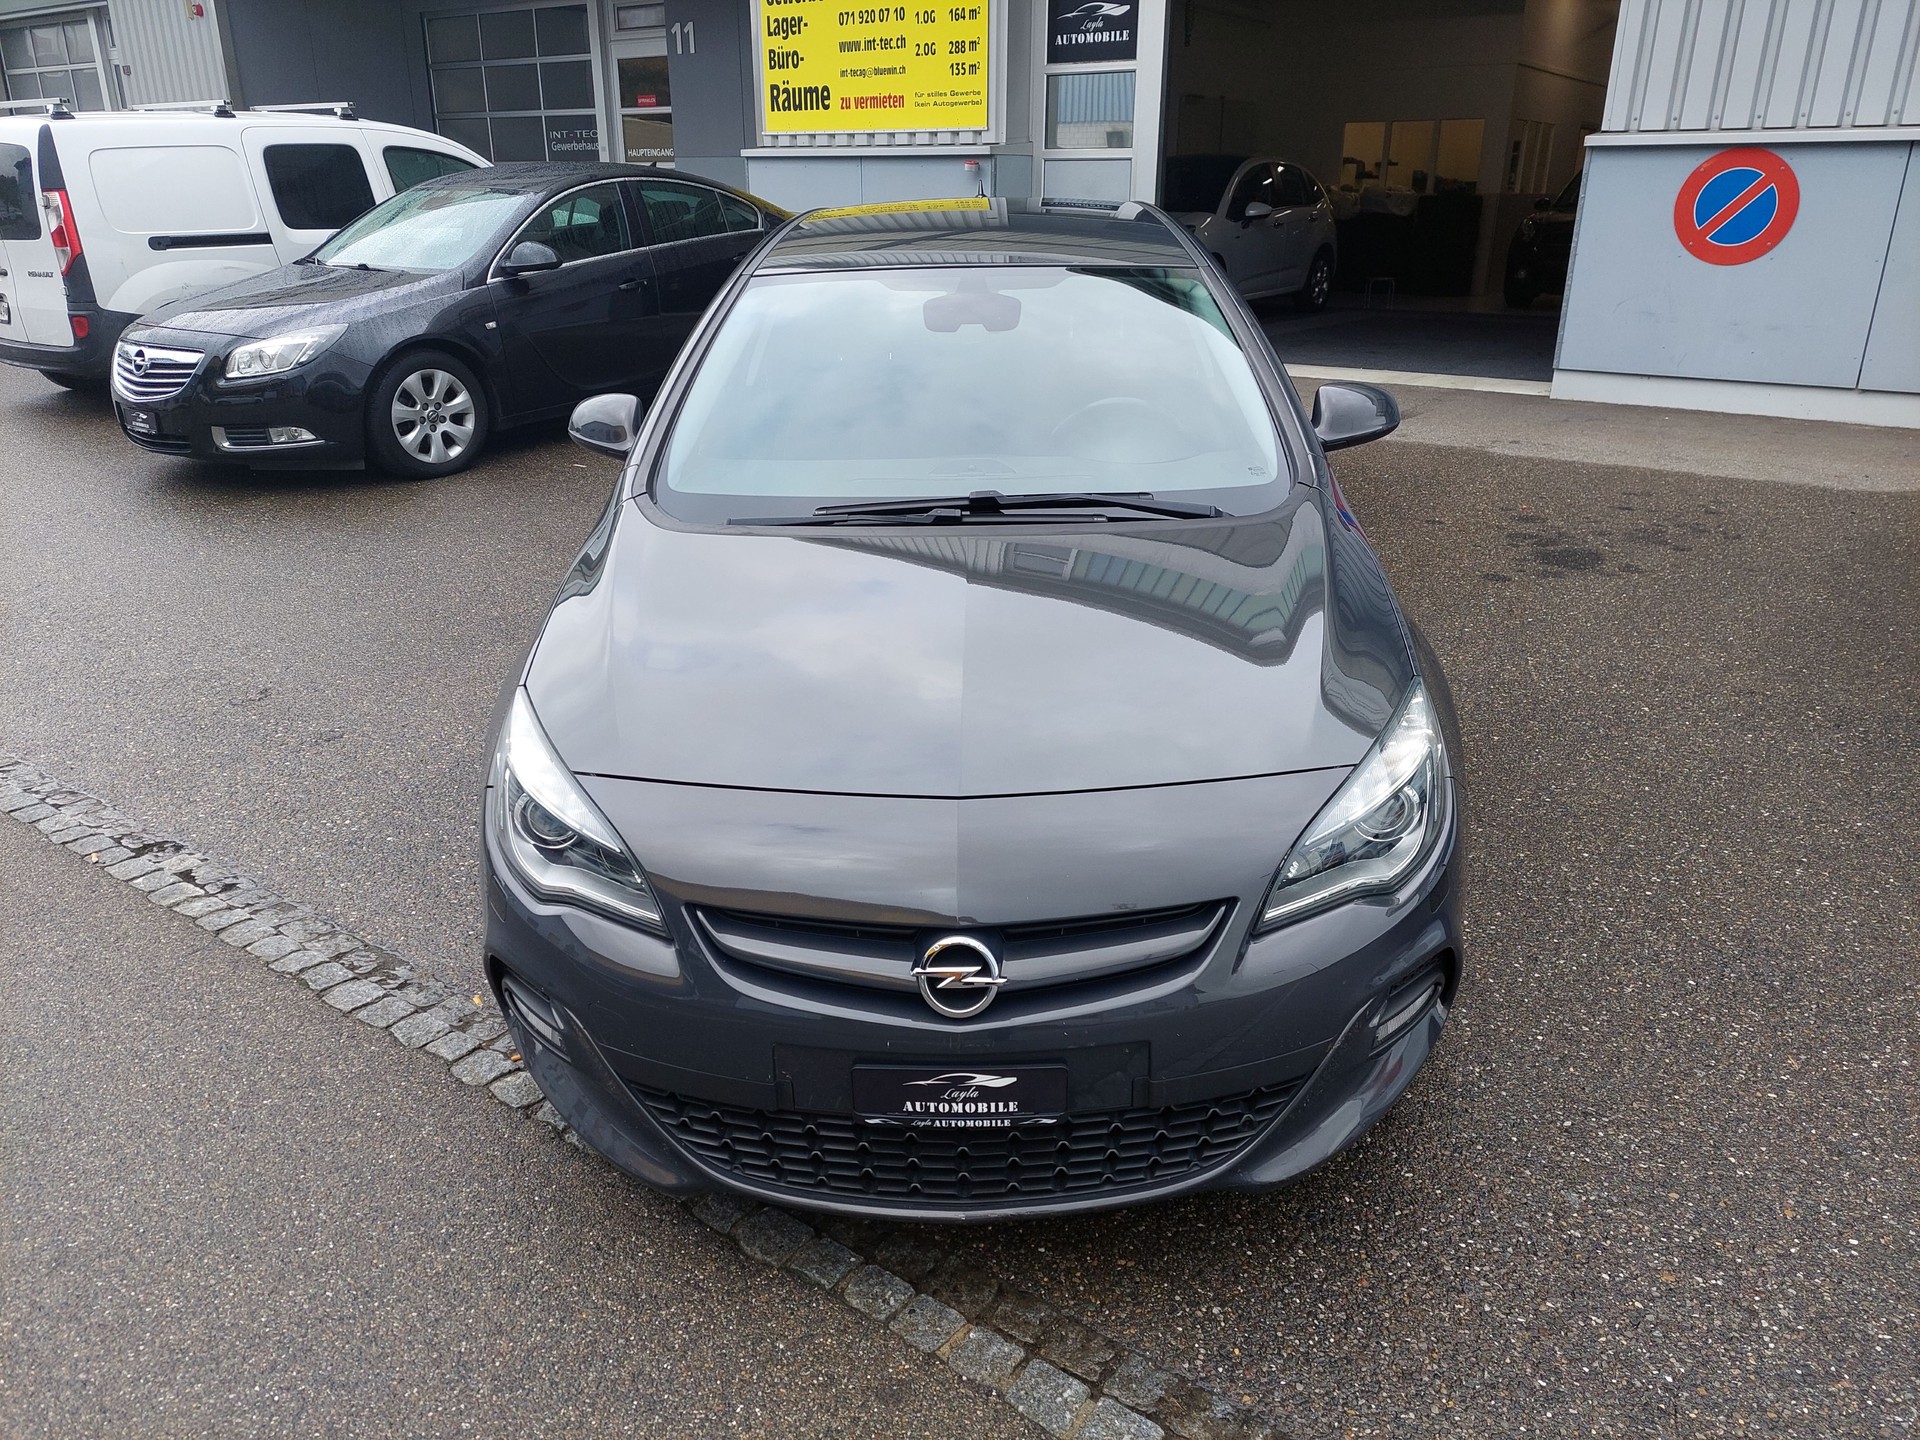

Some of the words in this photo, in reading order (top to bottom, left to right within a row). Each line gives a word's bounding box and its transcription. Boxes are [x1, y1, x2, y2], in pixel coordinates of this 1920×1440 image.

[839, 11, 855, 26] 071
[858, 9, 876, 24] 920
[878, 8, 890, 22] 07
[893, 6, 905, 21] 10
[915, 10, 936, 24] 1.OG
[948, 7, 966, 21] 164
[767, 15, 808, 40] Lager-
[1080, 16, 1104, 32] Layla
[670, 21, 696, 54] 11
[839, 34, 906, 53] www.int-tec.ch
[1055, 29, 1130, 45] AUTOMOBILE
[915, 42, 936, 56] 2.OG
[948, 40, 966, 54] 288
[768, 46, 804, 70] Büro-
[840, 65, 906, 78] int-tecag@bluewin.ch
[949, 62, 967, 76] 135
[770, 80, 831, 112] Räume
[840, 97, 851, 110] zu
[854, 92, 905, 109] vermieten
[927, 90, 948, 98] stilles
[949, 89, 982, 97] Gewerbe
[933, 98, 983, 108] Autogewerbe)
[551, 140, 600, 152] Gewerbehaus
[627, 148, 675, 157] HAUPTEINGANG
[940, 1085, 980, 1102] Layla
[902, 1101, 1019, 1114] AUTOMOBILE
[910, 1119, 932, 1127] Layla
[933, 1119, 1012, 1128] AUTOMOBILE
